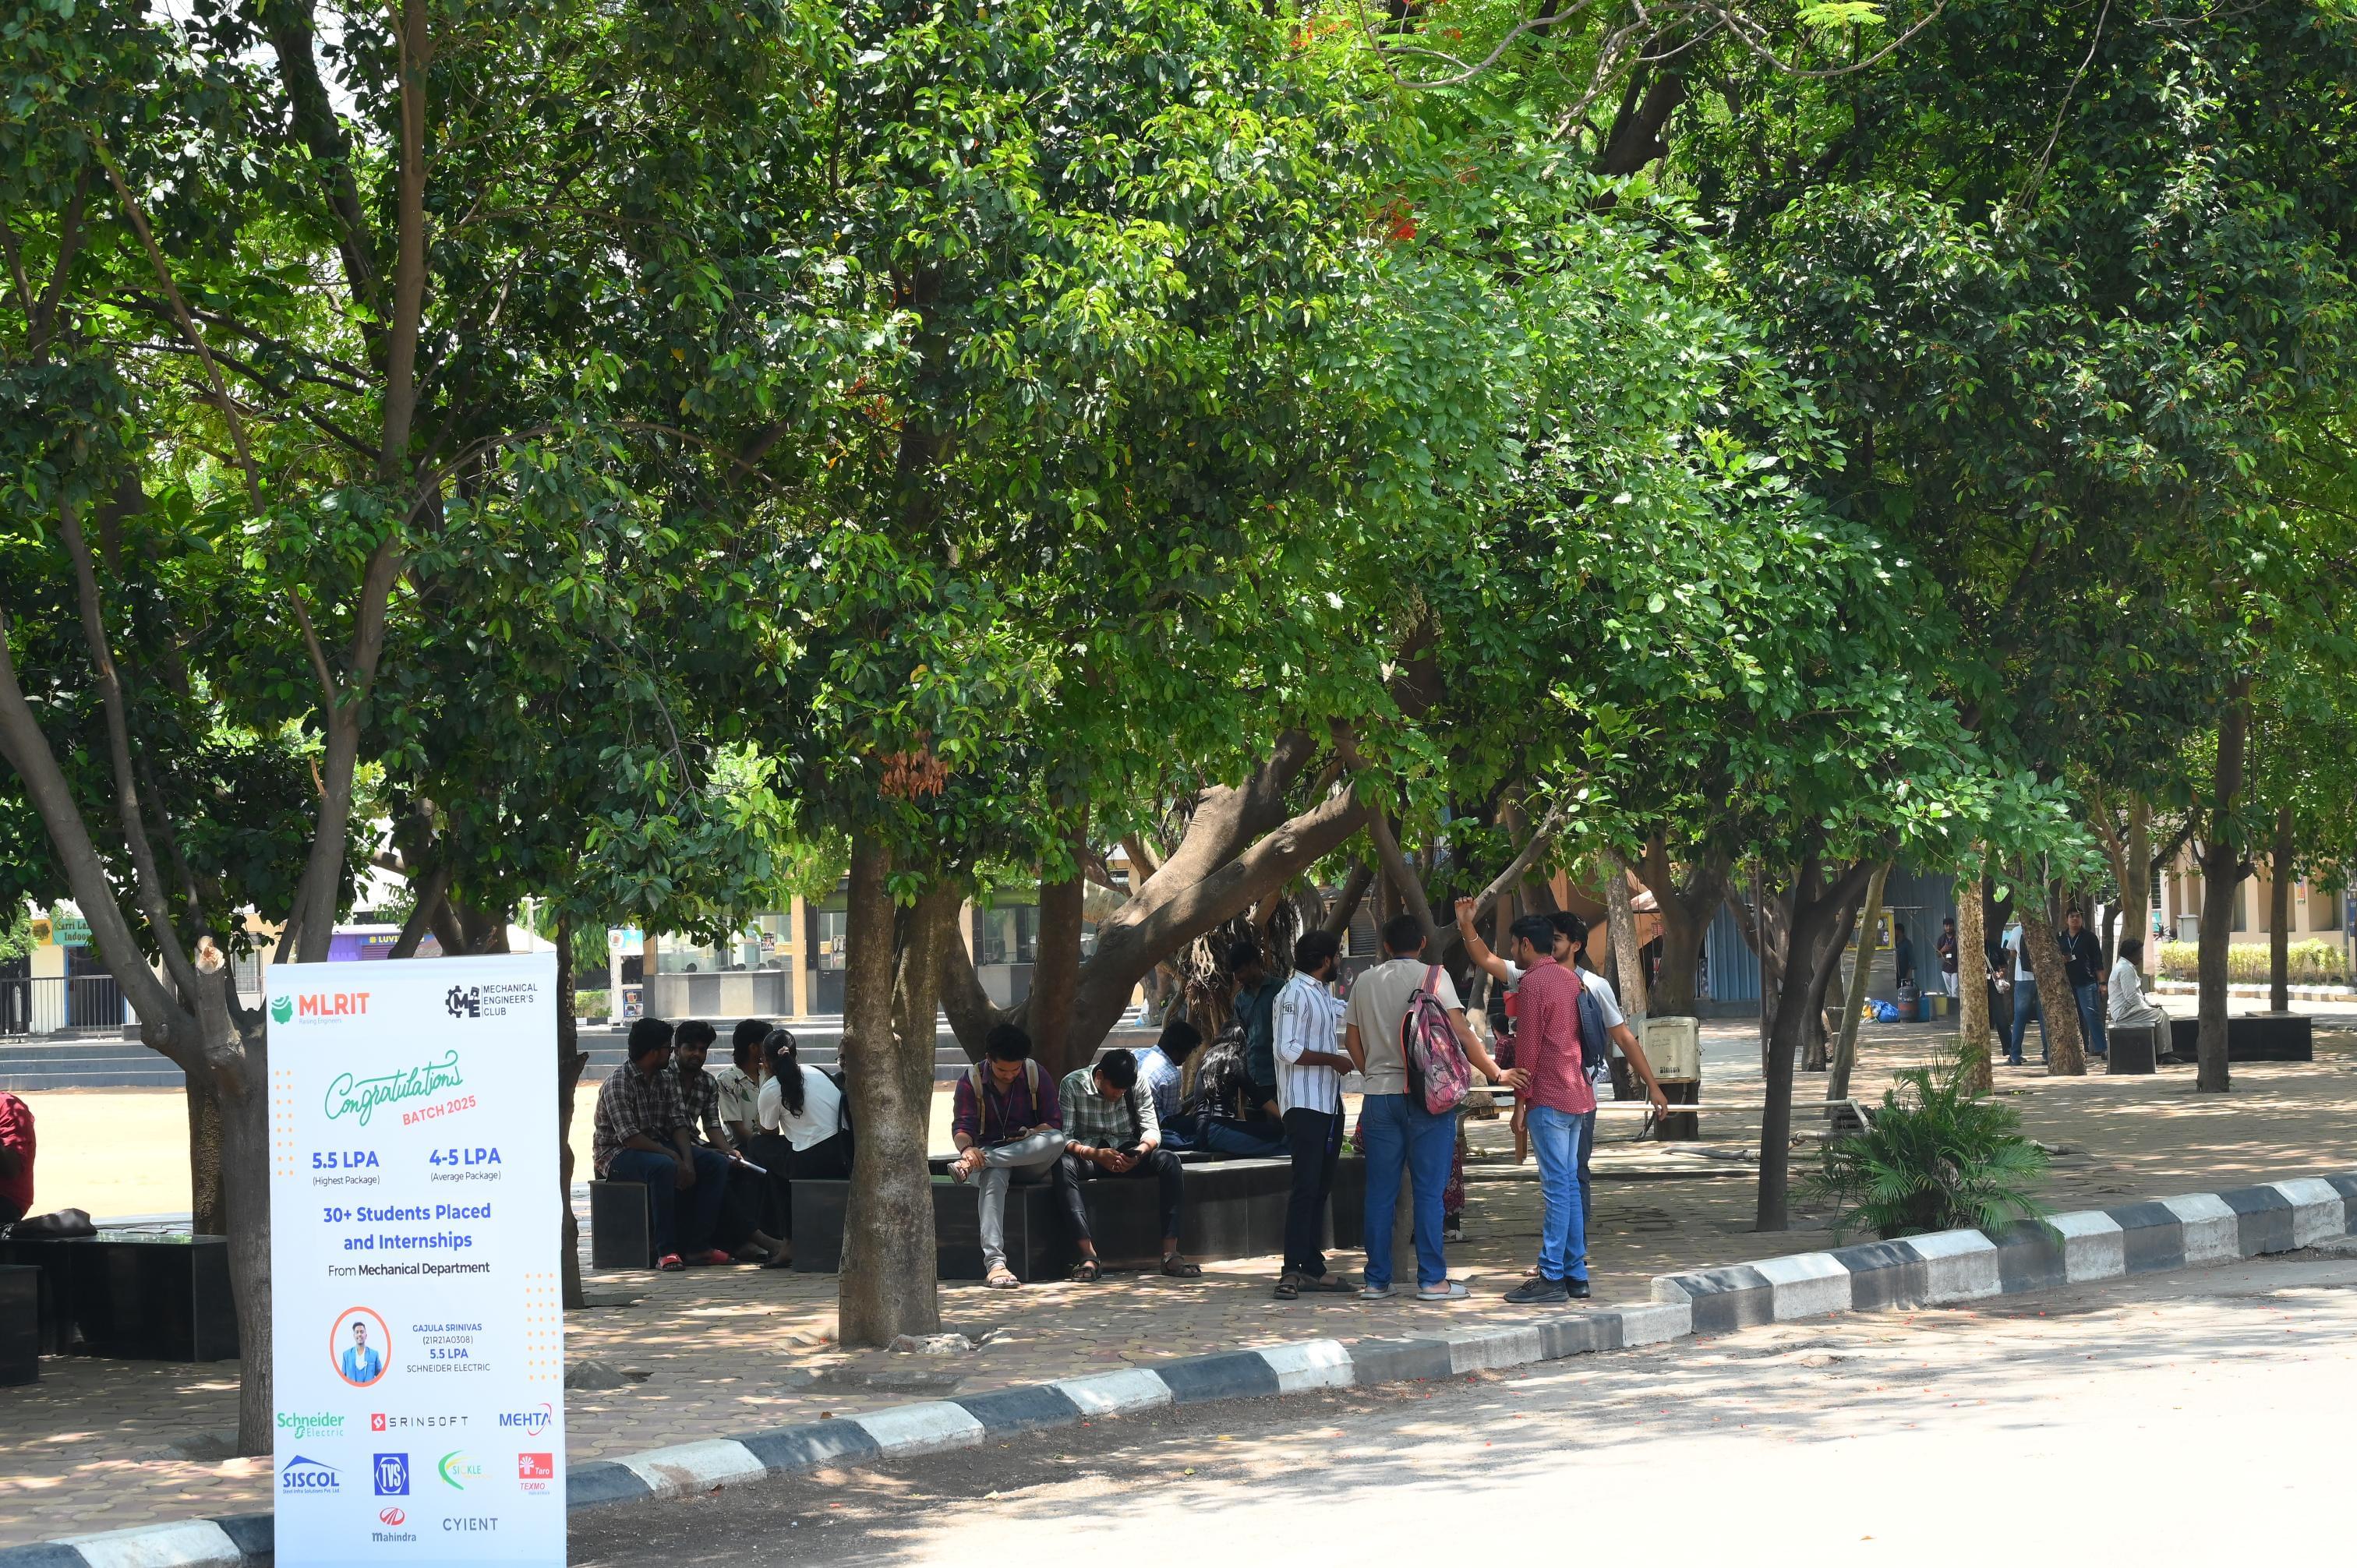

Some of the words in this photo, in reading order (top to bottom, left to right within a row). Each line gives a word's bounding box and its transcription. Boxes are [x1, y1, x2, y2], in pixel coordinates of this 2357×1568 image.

[483, 983, 539, 994] MECHANICAL
[299, 992, 369, 1016] MLRIT
[483, 994, 534, 1005] ENGINEER'S
[483, 1007, 507, 1016] CLUB
[324, 1050, 463, 1127] Congratulations
[402, 1104, 444, 1125] BATCH
[447, 1095, 476, 1114] 2025
[312, 1152, 338, 1169] 5.5
[344, 1150, 380, 1168] LPA
[429, 1149, 459, 1166] 4-5
[465, 1147, 502, 1165] LPA
[313, 1176, 344, 1186] (Highest
[345, 1174, 380, 1185] Package)
[430, 1172, 464, 1182] (Average
[466, 1171, 501, 1181] Package)
[323, 1208, 352, 1223] 30+
[357, 1205, 431, 1222] Students
[436, 1202, 491, 1219] Placed
[344, 1234, 374, 1250] and
[379, 1231, 472, 1252] Internships
[328, 1266, 356, 1277] From
[359, 1263, 420, 1277] Mechanical
[422, 1262, 490, 1277] Department
[412, 1324, 444, 1333] GAJULA
[445, 1323, 482, 1332] SRINIVAS
[429, 1349, 446, 1359] 5.5
[447, 1348, 468, 1358] LPA
[407, 1365, 452, 1373] SCHNEIDER
[454, 1363, 491, 1372] ELECTRIC
[277, 1412, 345, 1429] Schneider
[389, 1416, 468, 1427] SRINSOFT
[500, 1411, 551, 1427] MEHTA
[306, 1427, 344, 1437] Electric
[380, 1463, 401, 1487] TVS
[535, 1467, 550, 1475] Taro
[283, 1471, 339, 1488] SISCOL
[520, 1482, 546, 1491] TEXMO
[443, 1518, 498, 1531] CYIENT
